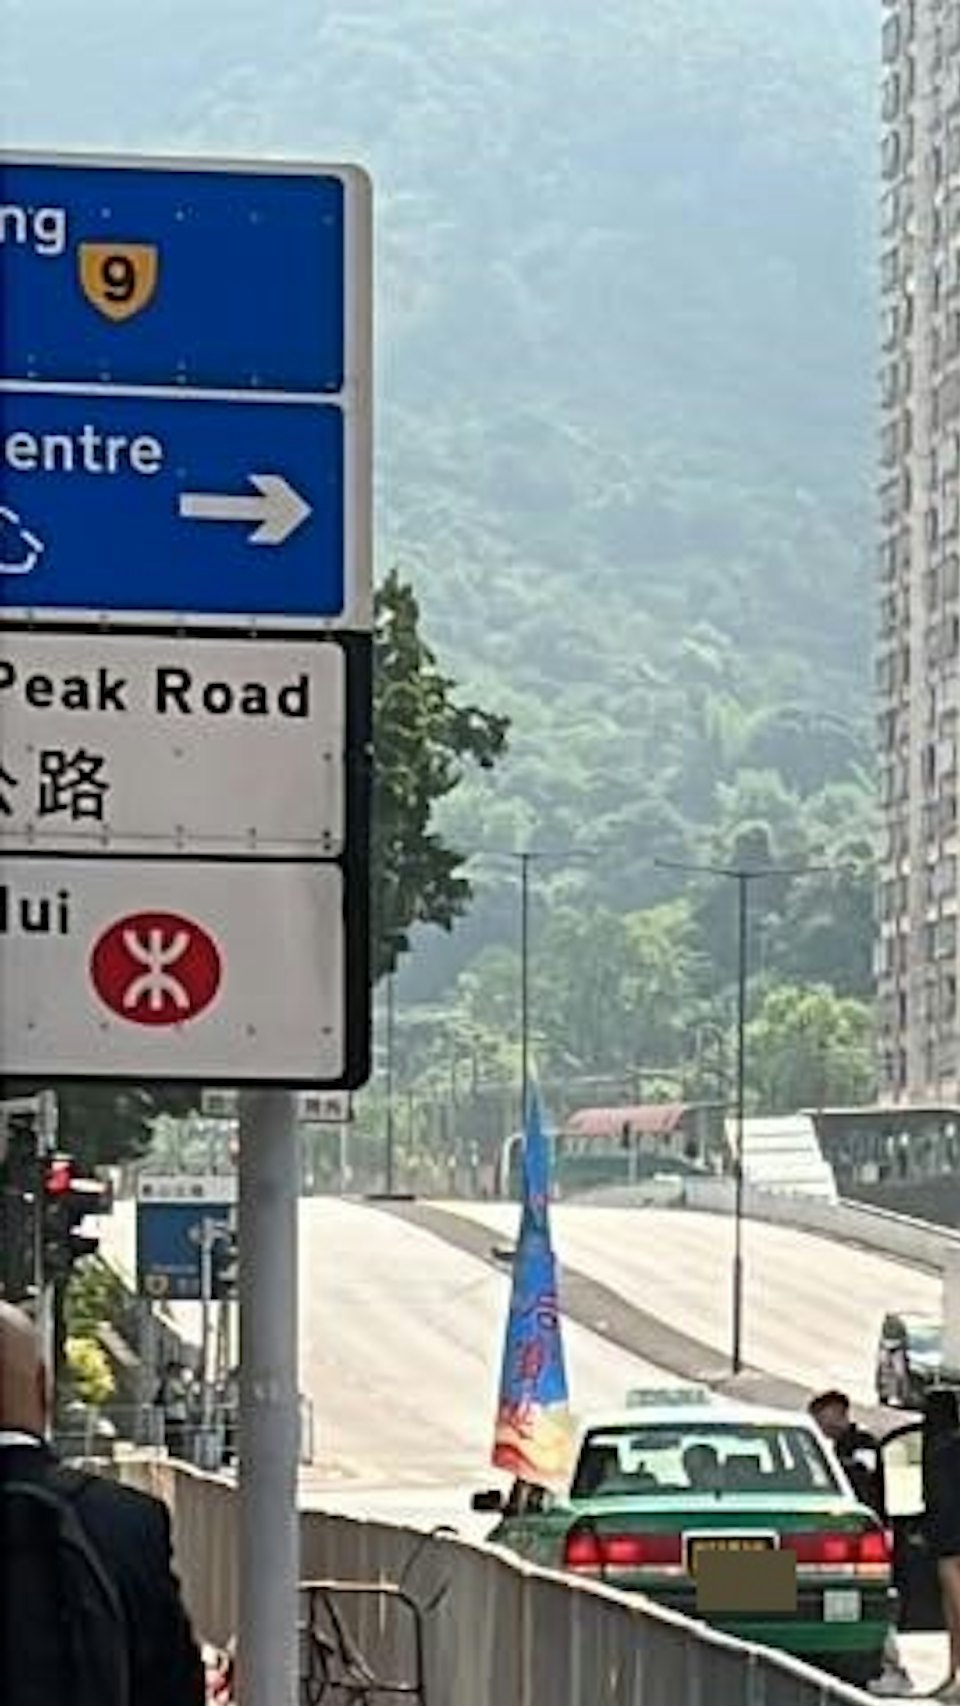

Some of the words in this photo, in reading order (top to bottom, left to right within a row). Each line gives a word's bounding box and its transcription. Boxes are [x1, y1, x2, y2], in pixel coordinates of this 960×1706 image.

[103, 256, 136, 301] 9
[5, 426, 163, 474] entre
[156, 668, 310, 718] Road
[0, 885, 69, 934] ui
